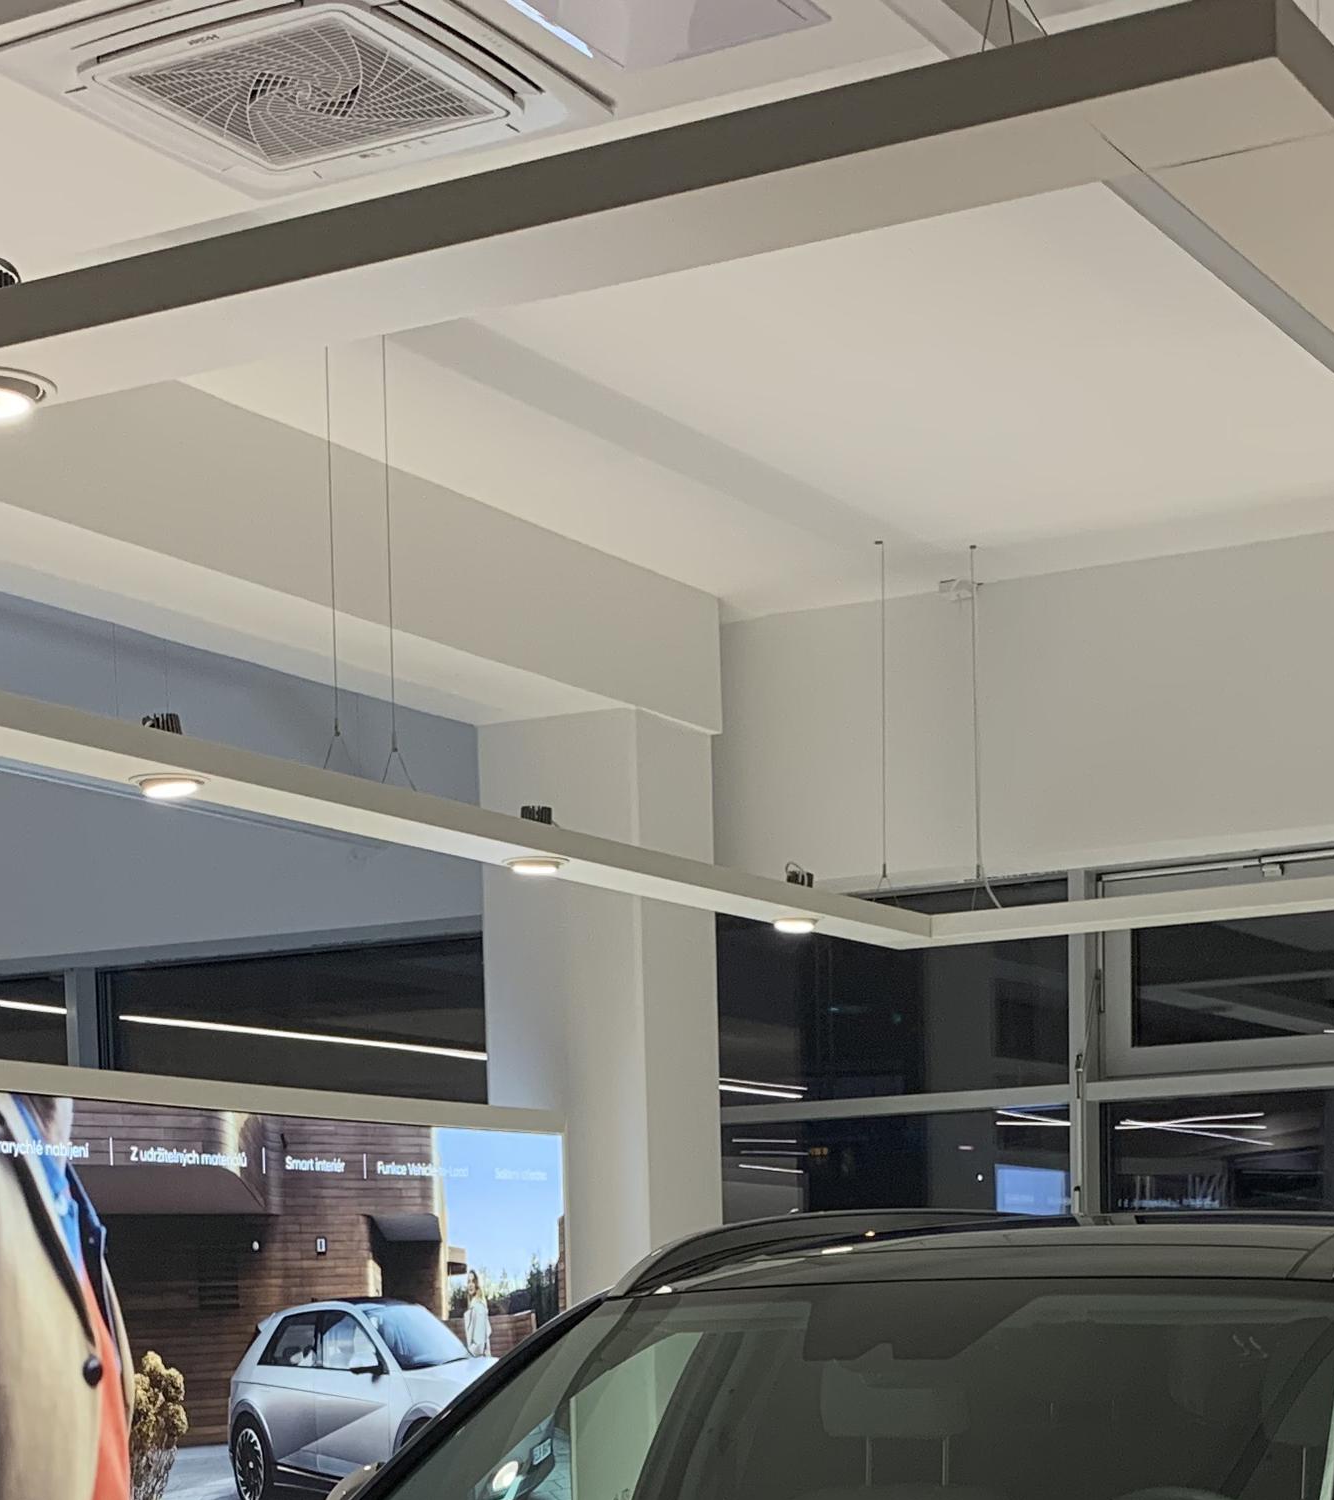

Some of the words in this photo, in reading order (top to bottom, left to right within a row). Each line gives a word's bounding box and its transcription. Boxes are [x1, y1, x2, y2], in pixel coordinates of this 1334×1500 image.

[45, 1140, 90, 1160] nabíjení
[129, 1145, 138, 1162] Z
[139, 1146, 200, 1167] udržitelných
[284, 1154, 315, 1171] Smart
[315, 1156, 346, 1173] interiér
[376, 1160, 407, 1176] Funkce
